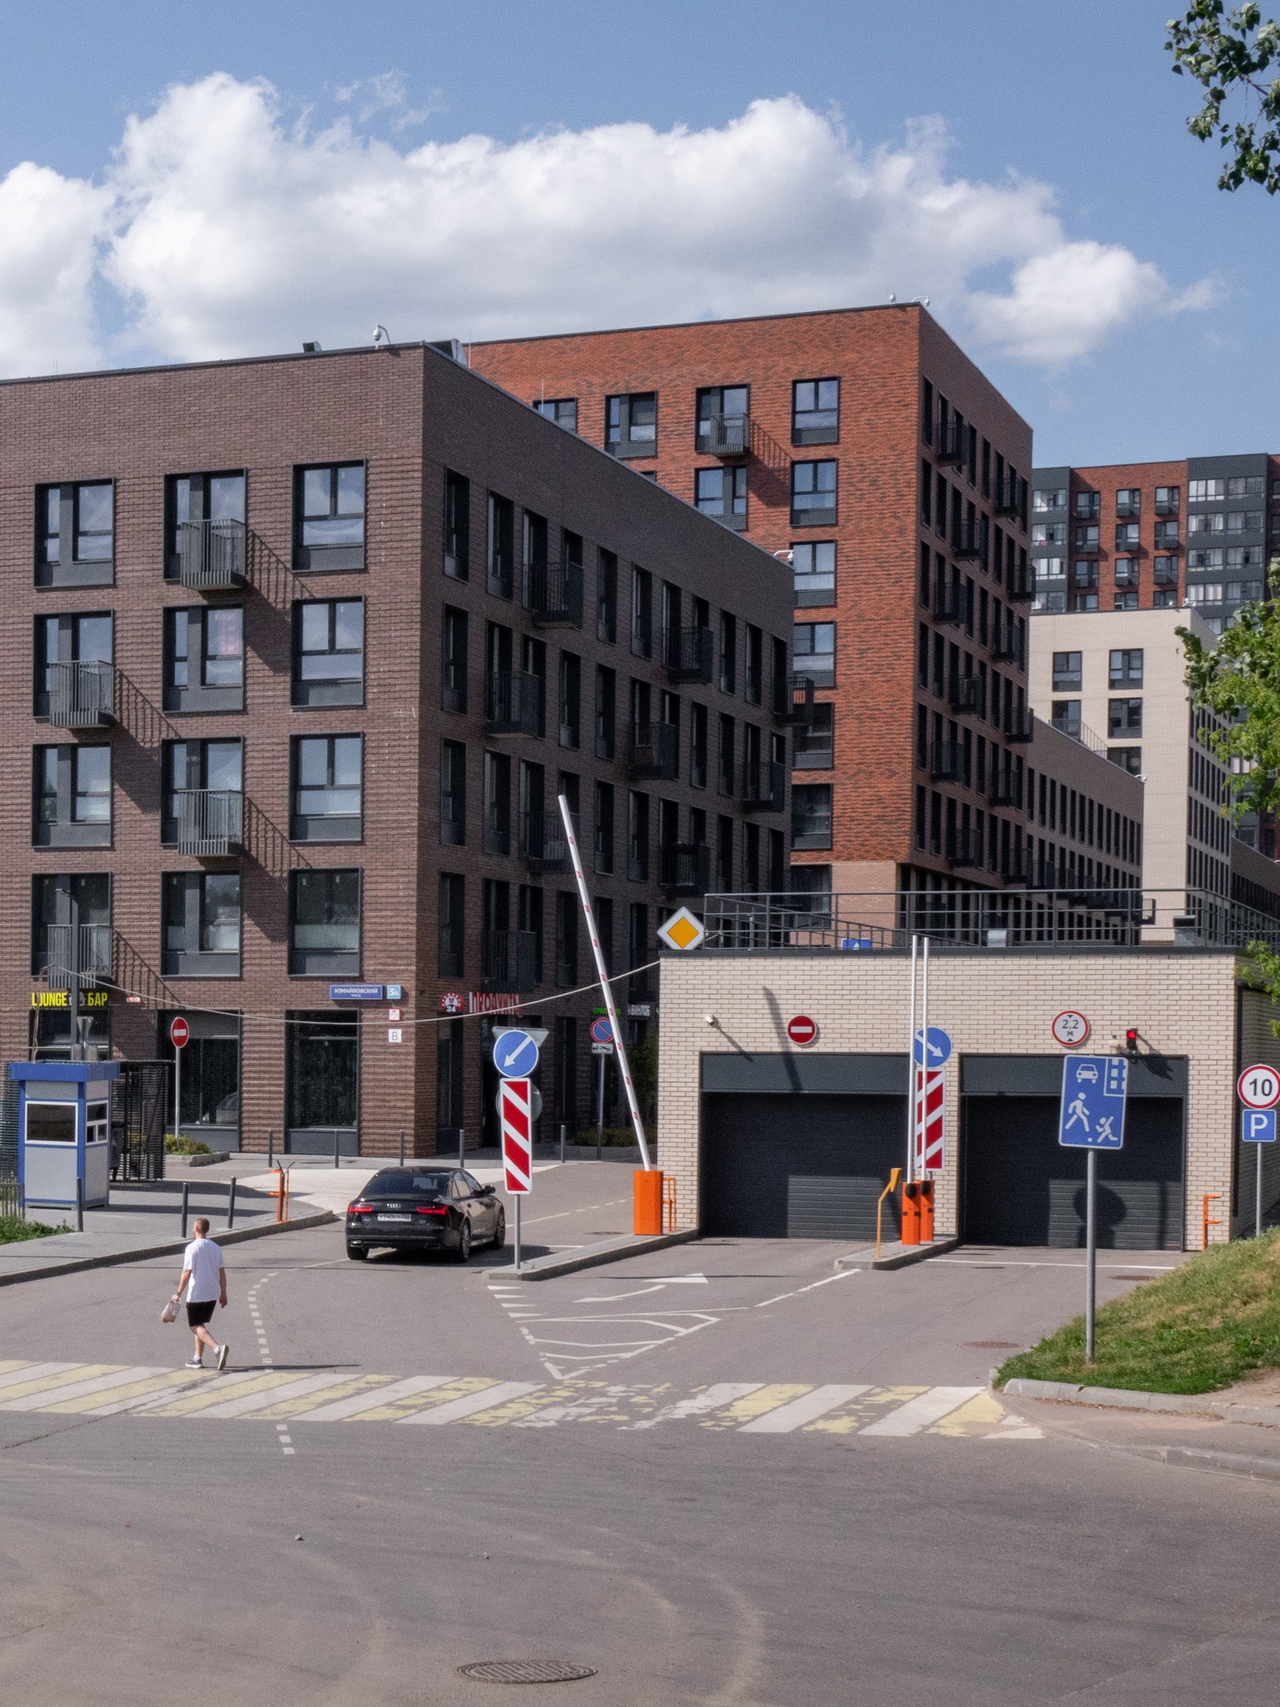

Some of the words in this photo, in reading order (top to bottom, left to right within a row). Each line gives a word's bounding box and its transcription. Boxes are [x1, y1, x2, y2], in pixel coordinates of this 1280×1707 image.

[87, 992, 108, 1007] БАР
[389, 988, 399, 996] 5А
[446, 1004, 456, 1013] 24
[1249, 1078, 1273, 1097] 10
[1250, 1113, 1268, 1138] P
